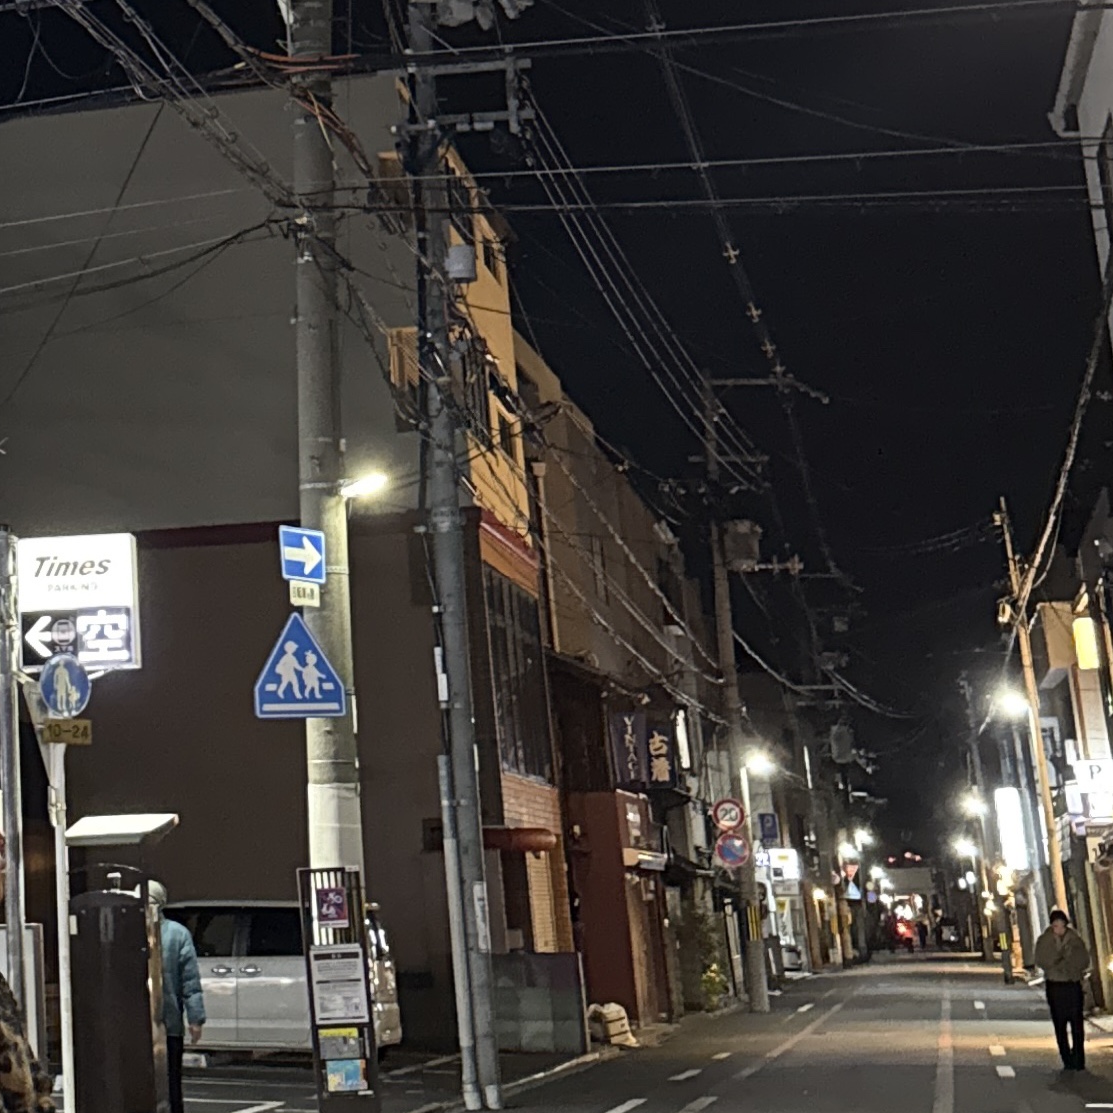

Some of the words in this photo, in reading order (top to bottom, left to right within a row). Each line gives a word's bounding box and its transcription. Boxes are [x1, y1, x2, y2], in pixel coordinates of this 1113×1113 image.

[34, 556, 111, 577] Times
[47, 582, 98, 592] PARKNG
[76, 609, 130, 662] 空
[720, 807, 738, 823] 20
